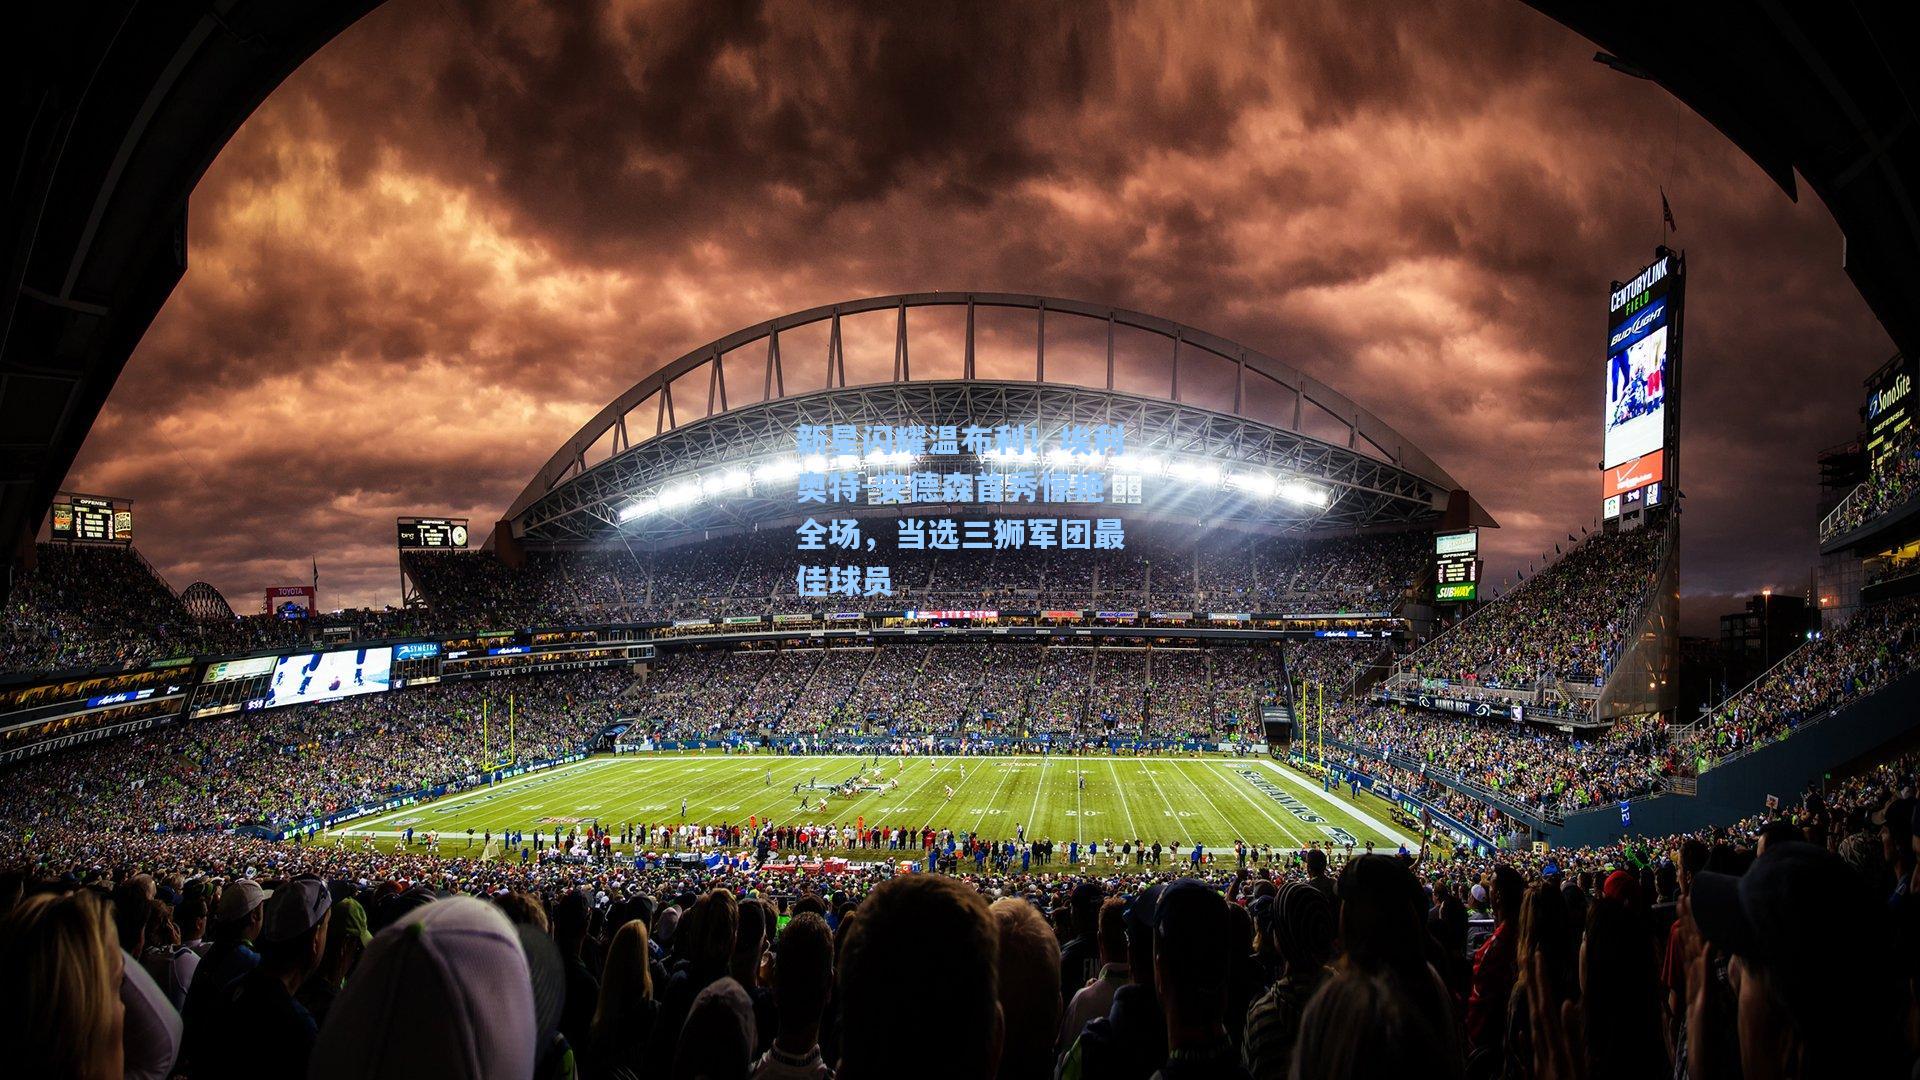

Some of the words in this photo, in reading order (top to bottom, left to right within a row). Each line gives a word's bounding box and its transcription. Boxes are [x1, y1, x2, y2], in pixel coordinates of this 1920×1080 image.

[1610, 256, 1668, 313] CENTURYLINK
[1625, 290, 1650, 316] FIELD
[1610, 327, 1632, 347] BUD
[1634, 305, 1664, 332] LIGHT
[1877, 374, 1911, 414] SonoSite
[80, 499, 107, 507] OFFENSE
[279, 587, 304, 595] TOYOTA
[1437, 585, 1474, 599] SUBWAY
[410, 644, 438, 653] SYMETRA
[490, 669, 516, 677] HOME
[10, 750, 24, 761] TO
[30, 728, 112, 756] CENTURYLINK
[117, 720, 153, 735] FIELD
[1233, 768, 1329, 824] SEAHAWKS
[1620, 806, 1630, 822] 12
